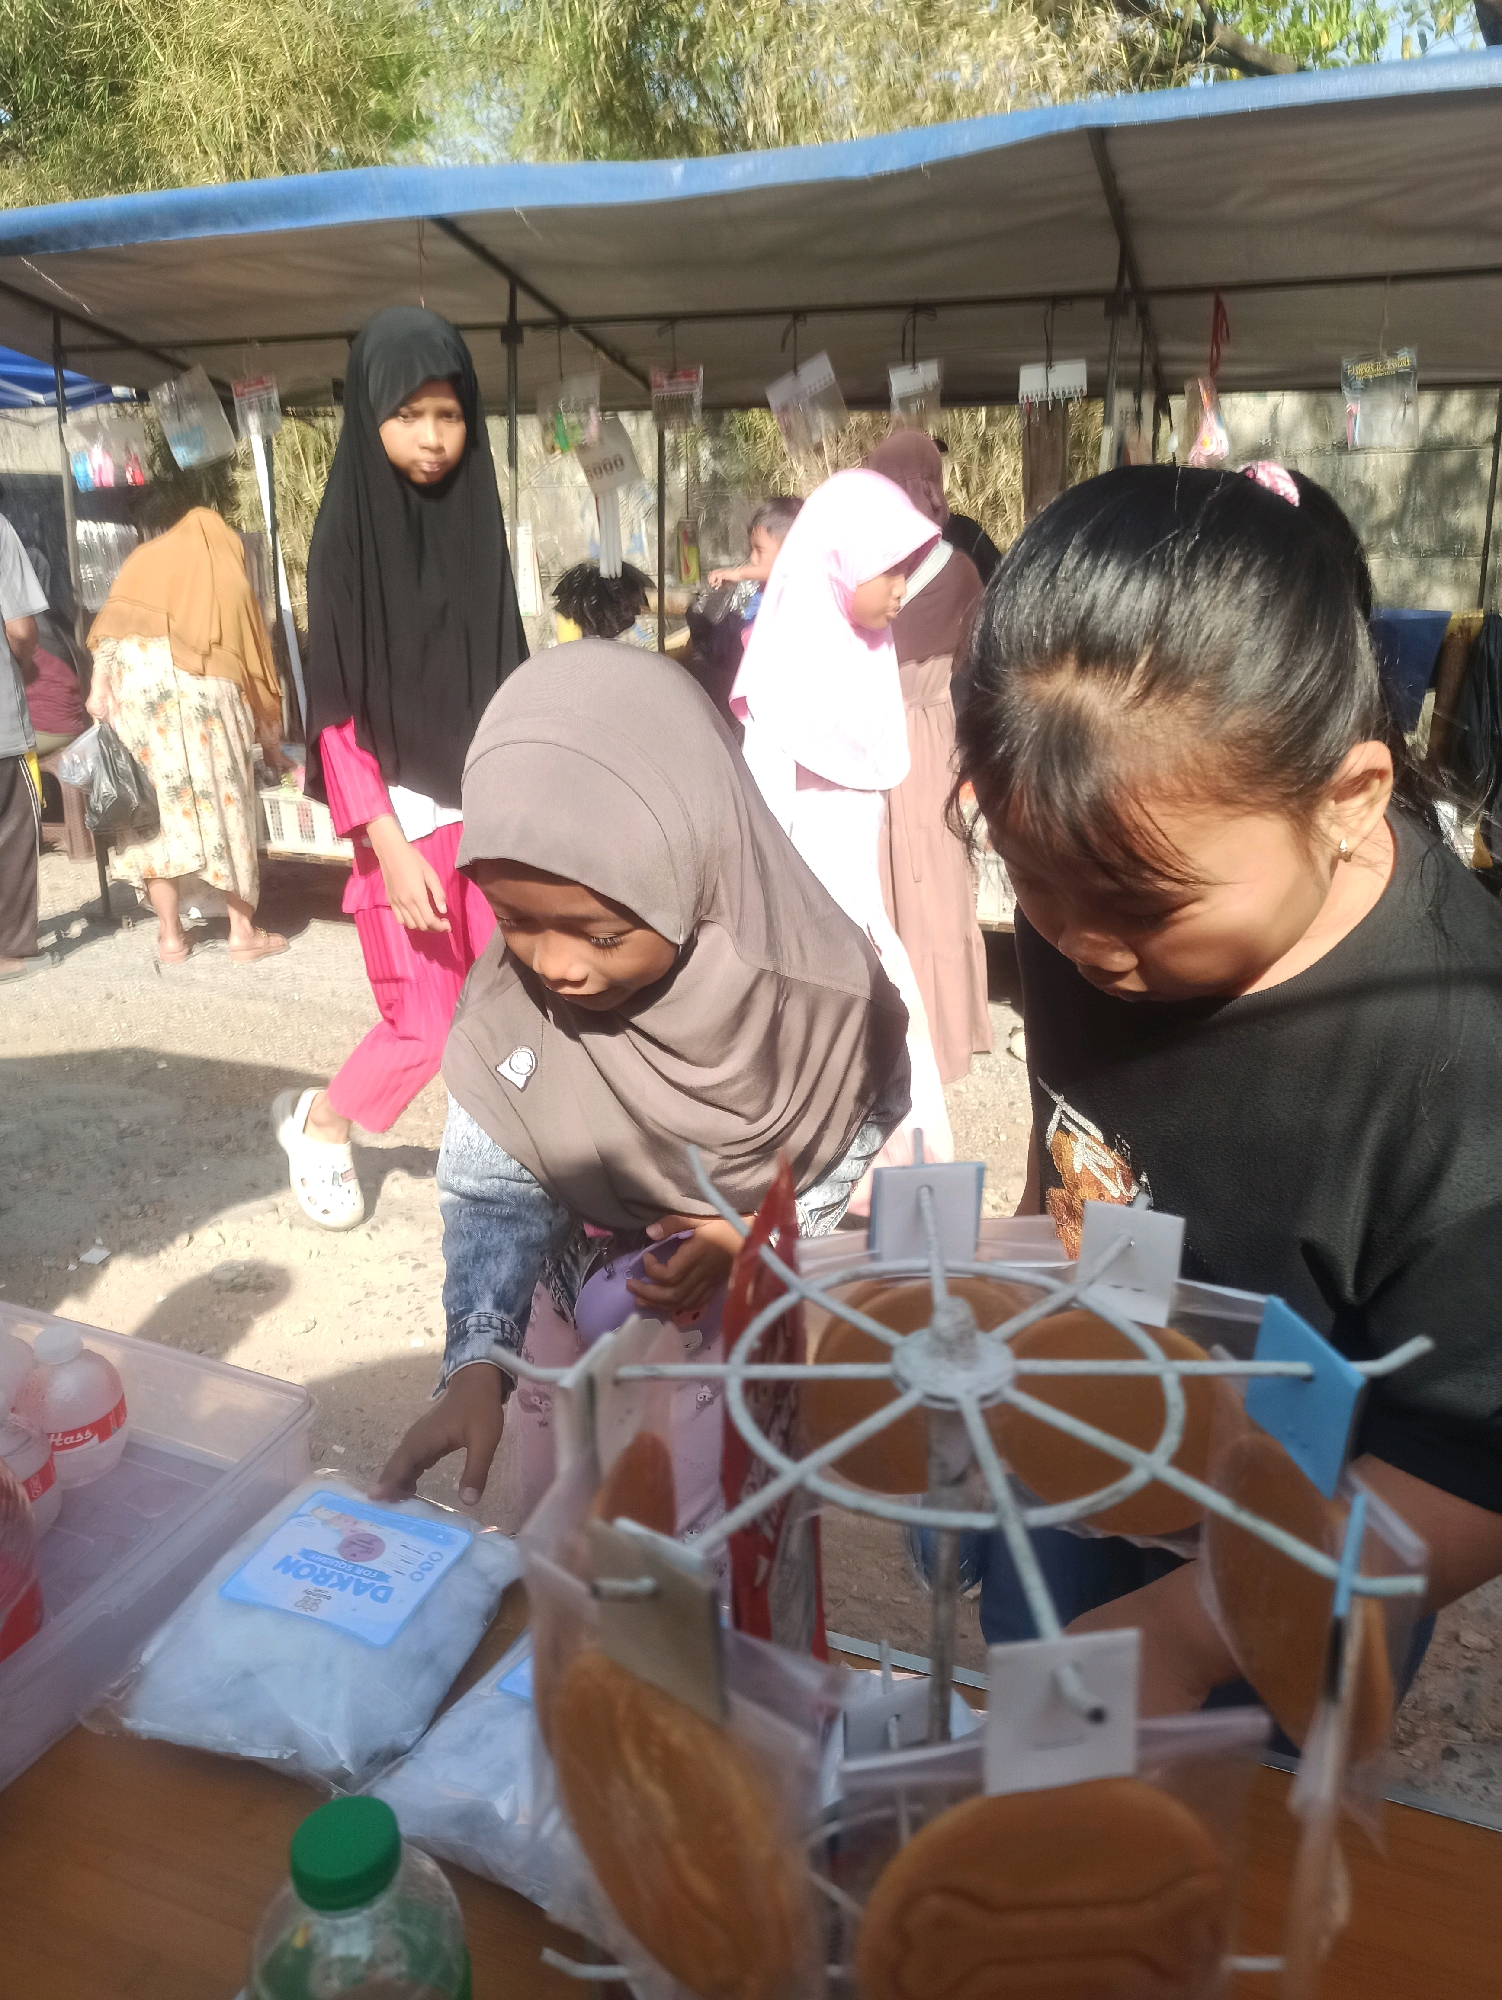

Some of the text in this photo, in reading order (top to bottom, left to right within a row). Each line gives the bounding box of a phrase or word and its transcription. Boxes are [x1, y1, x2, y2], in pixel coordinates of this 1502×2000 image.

[308, 1554, 354, 1572] SQUISHY
[272, 1555, 394, 1604] DAKRON
[355, 1567, 379, 1578] FOR
